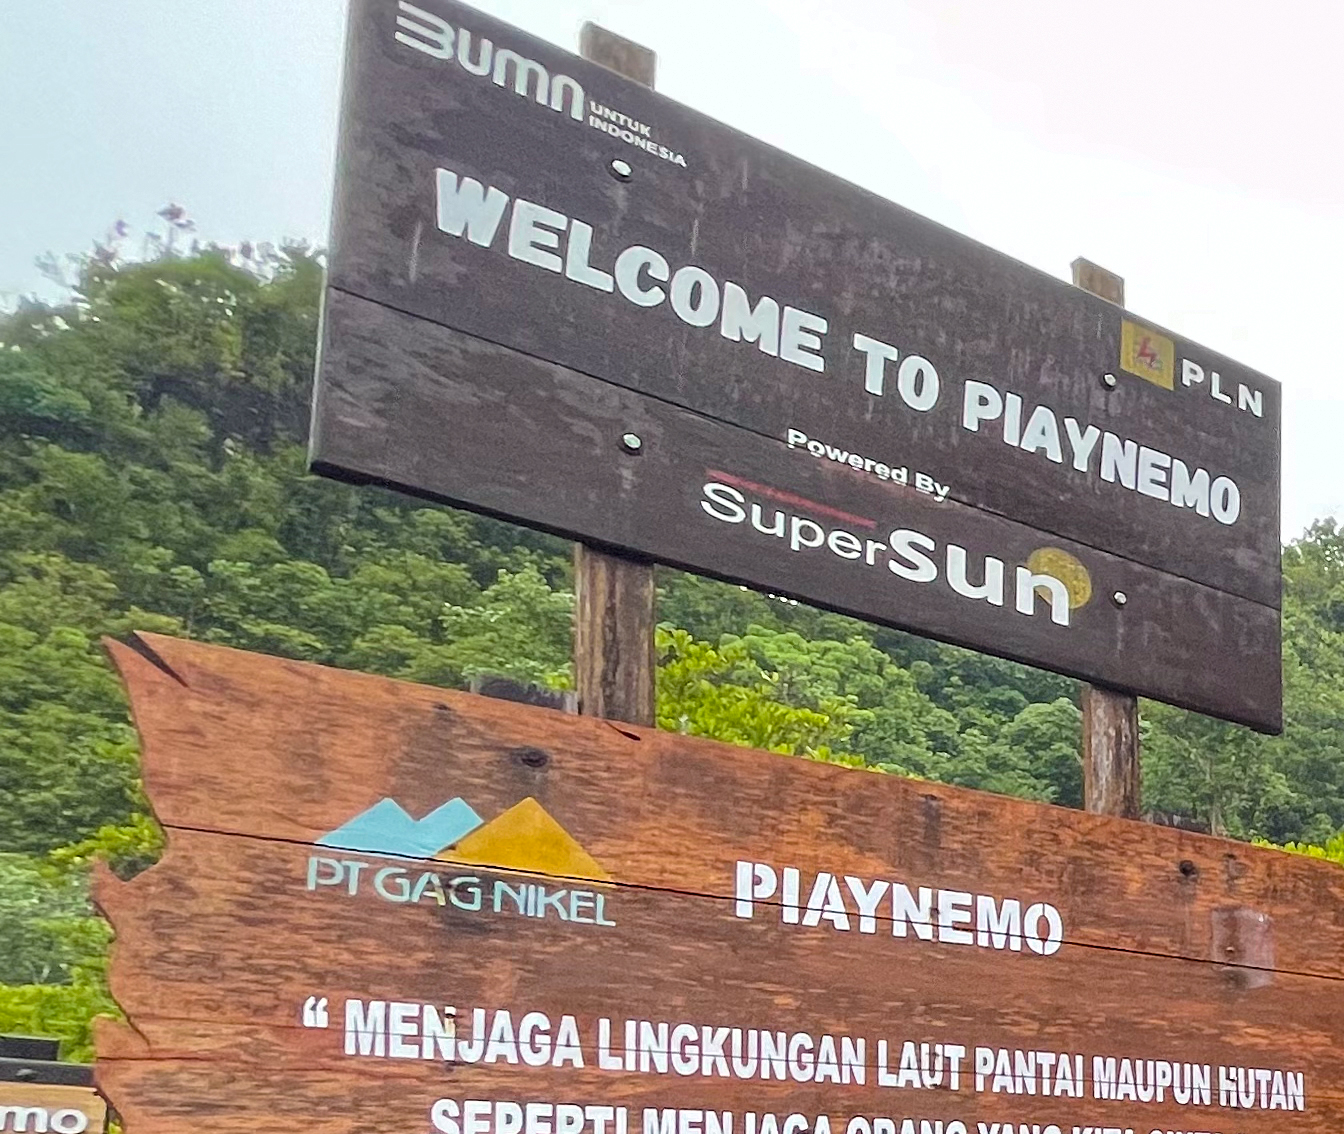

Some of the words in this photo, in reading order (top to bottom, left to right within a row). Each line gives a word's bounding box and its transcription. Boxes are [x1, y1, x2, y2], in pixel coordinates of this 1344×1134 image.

[588, 115, 687, 168] INDONESIA
[589, 101, 651, 138] UNTUK
[435, 167, 828, 373] WELCOME
[854, 333, 940, 412] TO
[962, 379, 1241, 525] PIAYNEMO
[1182, 358, 1263, 418] PLN
[787, 428, 908, 487] Powered
[915, 472, 950, 502] By
[307, 857, 369, 895] PT
[374, 868, 482, 911] GAG
[493, 881, 617, 927] NIKEL
[735, 860, 1064, 956] PIAYNEMO
[345, 1000, 585, 1069] MENJAGA
[599, 1018, 866, 1086] LINGKUNGAN
[877, 1039, 966, 1092] LAUT
[976, 1047, 1084, 1099] PANTAI
[1093, 1057, 1211, 1107] MAUPUN
[1219, 1066, 1305, 1111] HUTAN
